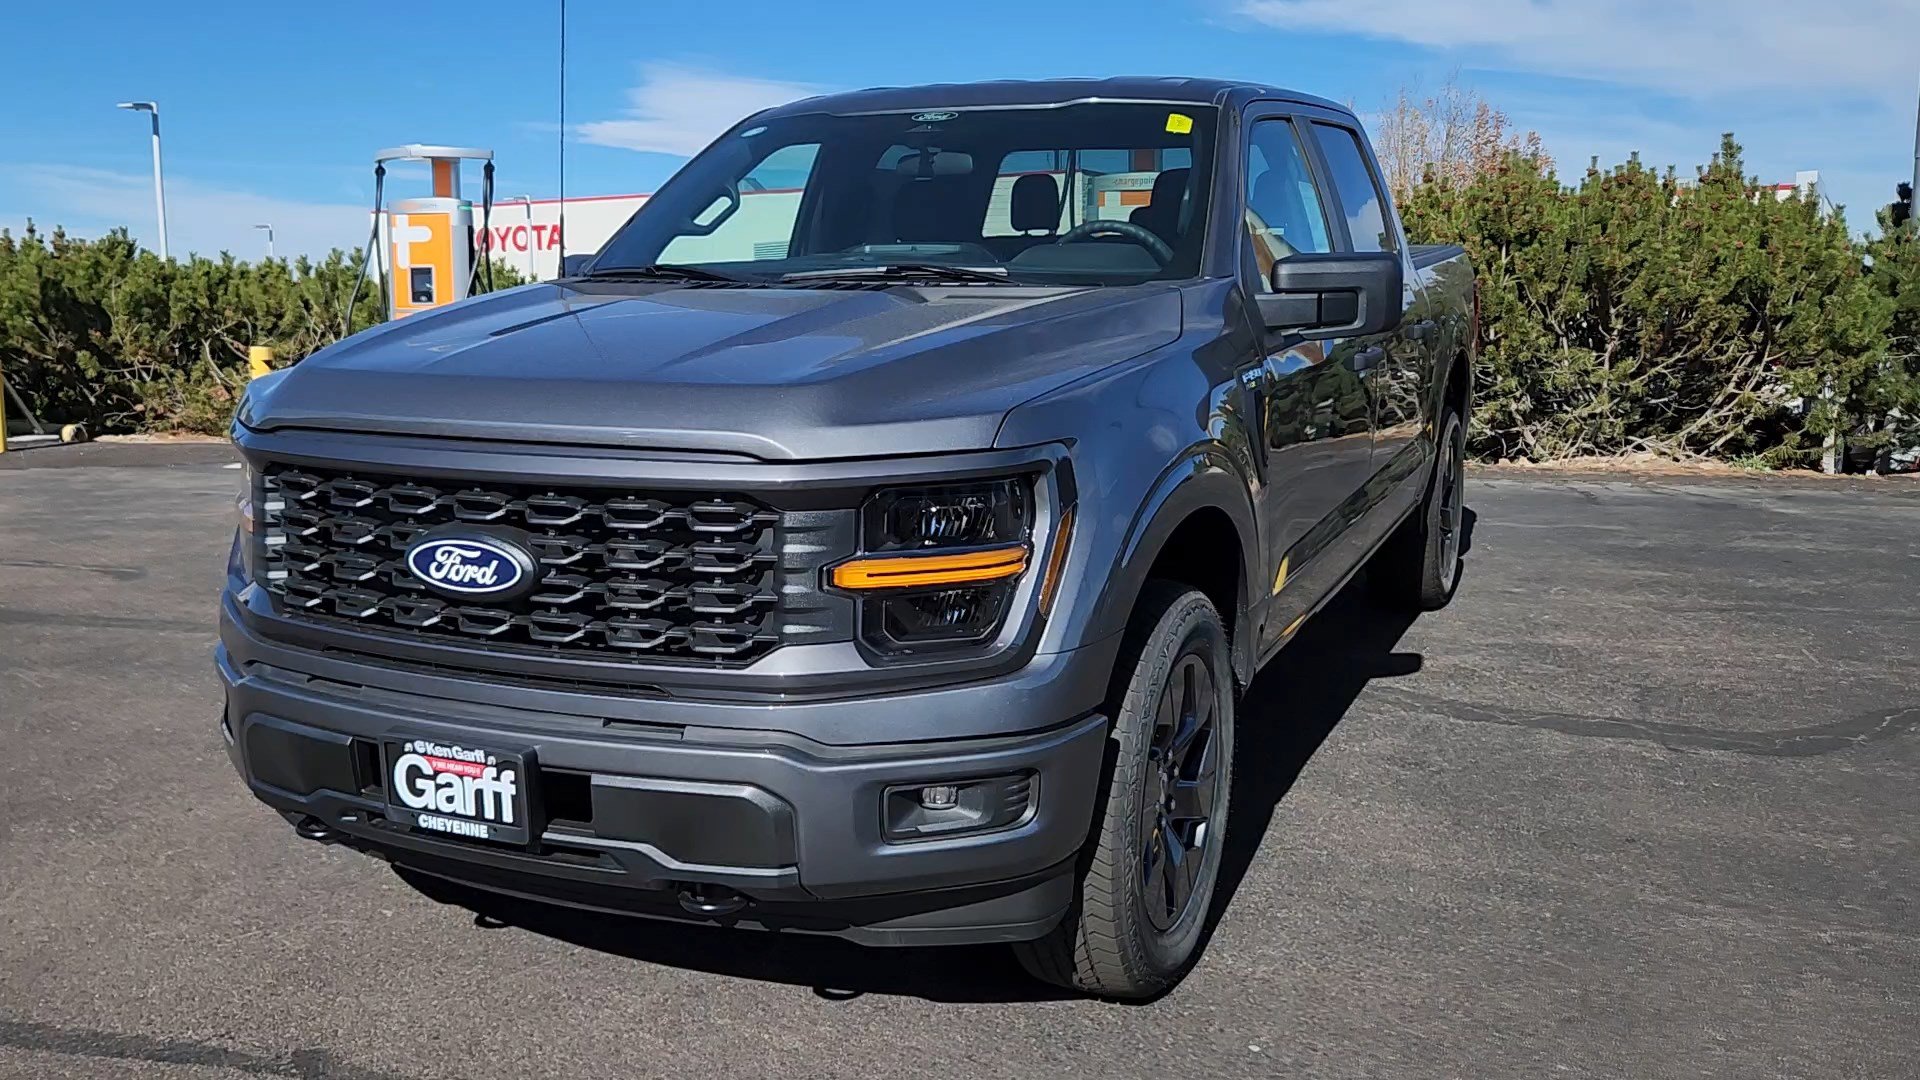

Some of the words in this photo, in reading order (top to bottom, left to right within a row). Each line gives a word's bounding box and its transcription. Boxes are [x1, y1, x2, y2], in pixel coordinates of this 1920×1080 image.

[1114, 176, 1155, 186] chargepoin
[476, 224, 561, 253] OYOTA
[429, 546, 500, 585] Ford
[393, 753, 517, 823] Garff
[417, 814, 489, 838] CHEYENNE
